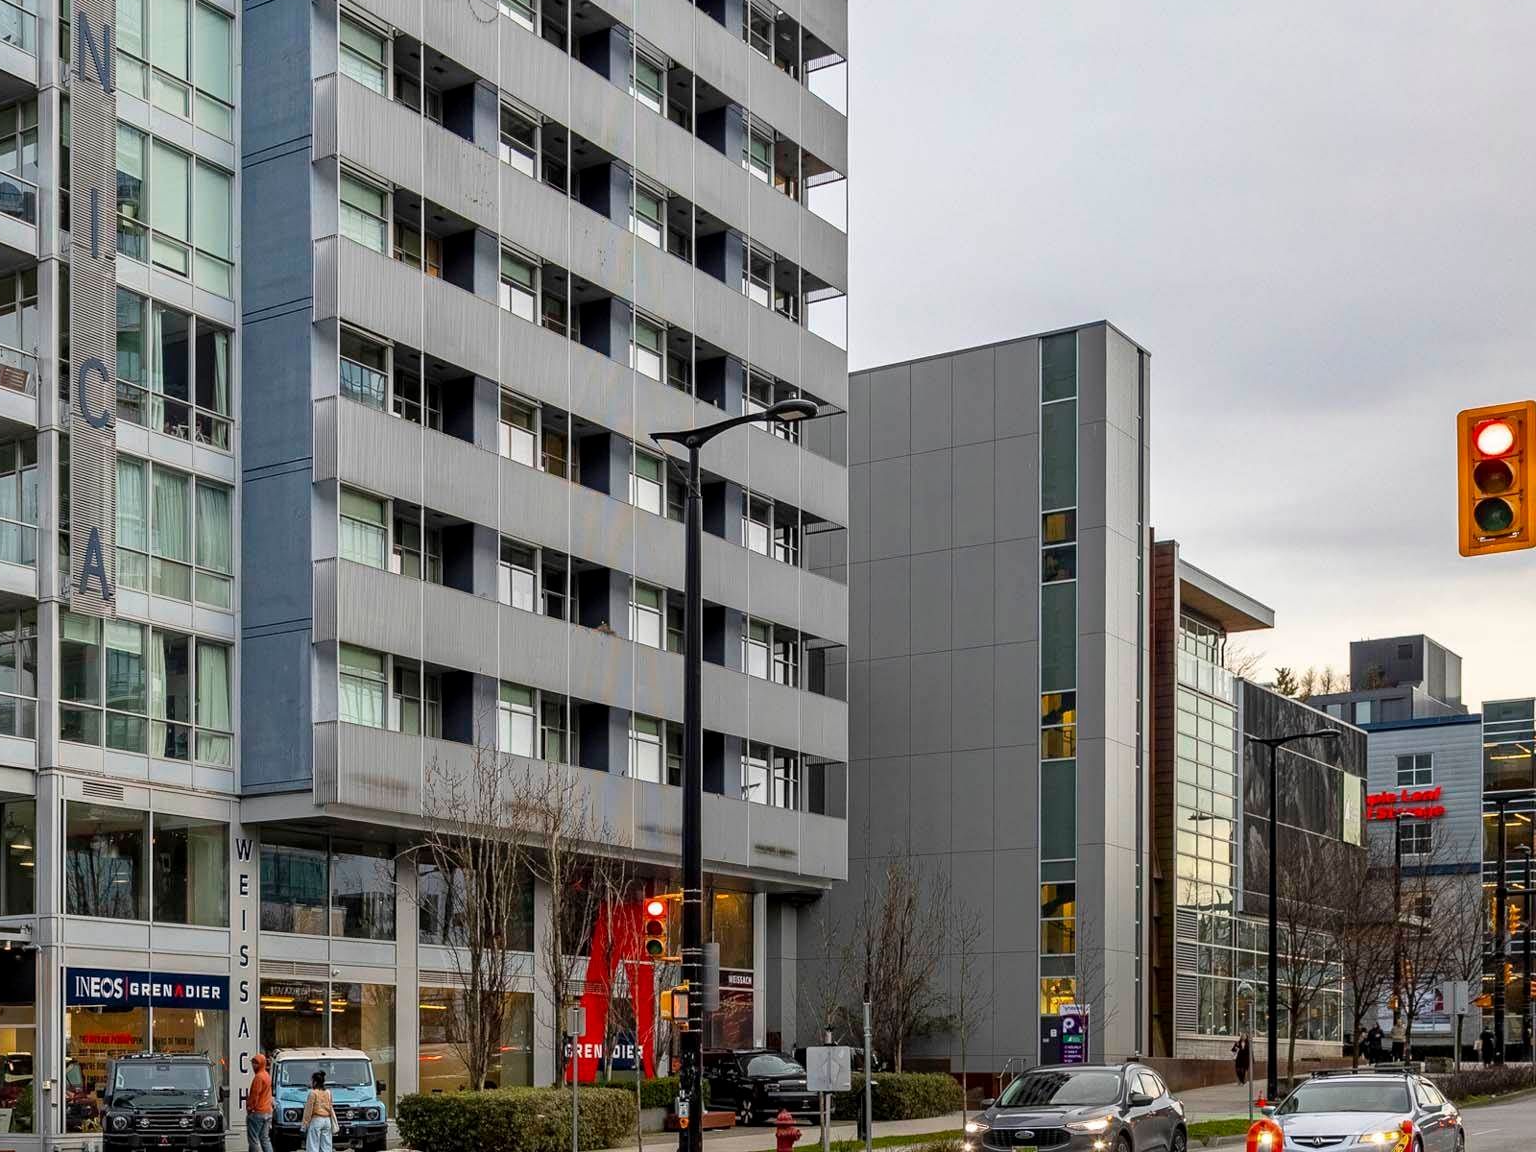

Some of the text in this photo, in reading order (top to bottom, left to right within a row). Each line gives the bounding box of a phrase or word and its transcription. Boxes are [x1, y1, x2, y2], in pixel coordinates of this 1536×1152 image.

[236, 838, 252, 1109] WEISSACH
[75, 975, 221, 999] INEOS GRENADIER
[565, 1044, 644, 1059] GRENDIER
